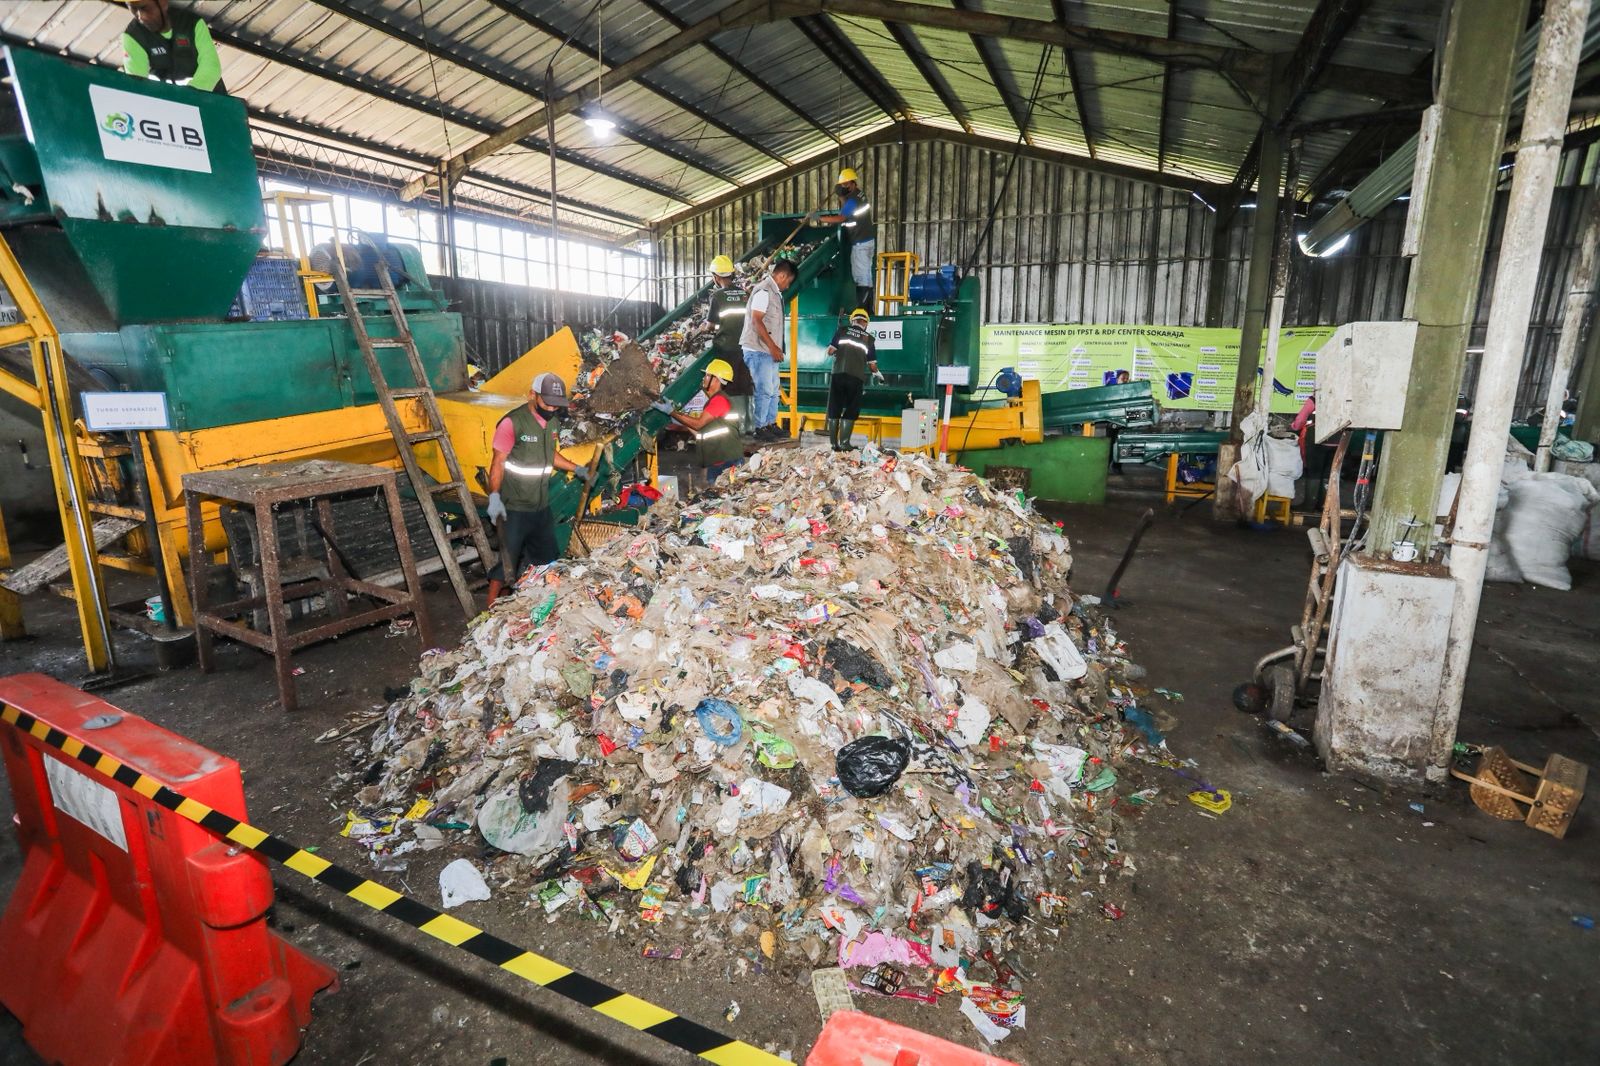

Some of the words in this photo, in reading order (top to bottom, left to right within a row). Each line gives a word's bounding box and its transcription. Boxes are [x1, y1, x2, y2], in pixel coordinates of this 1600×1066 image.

[139, 119, 203, 147] GIB
[878, 330, 902, 339] GIB
[1147, 329, 1185, 338] SOKARAJA
